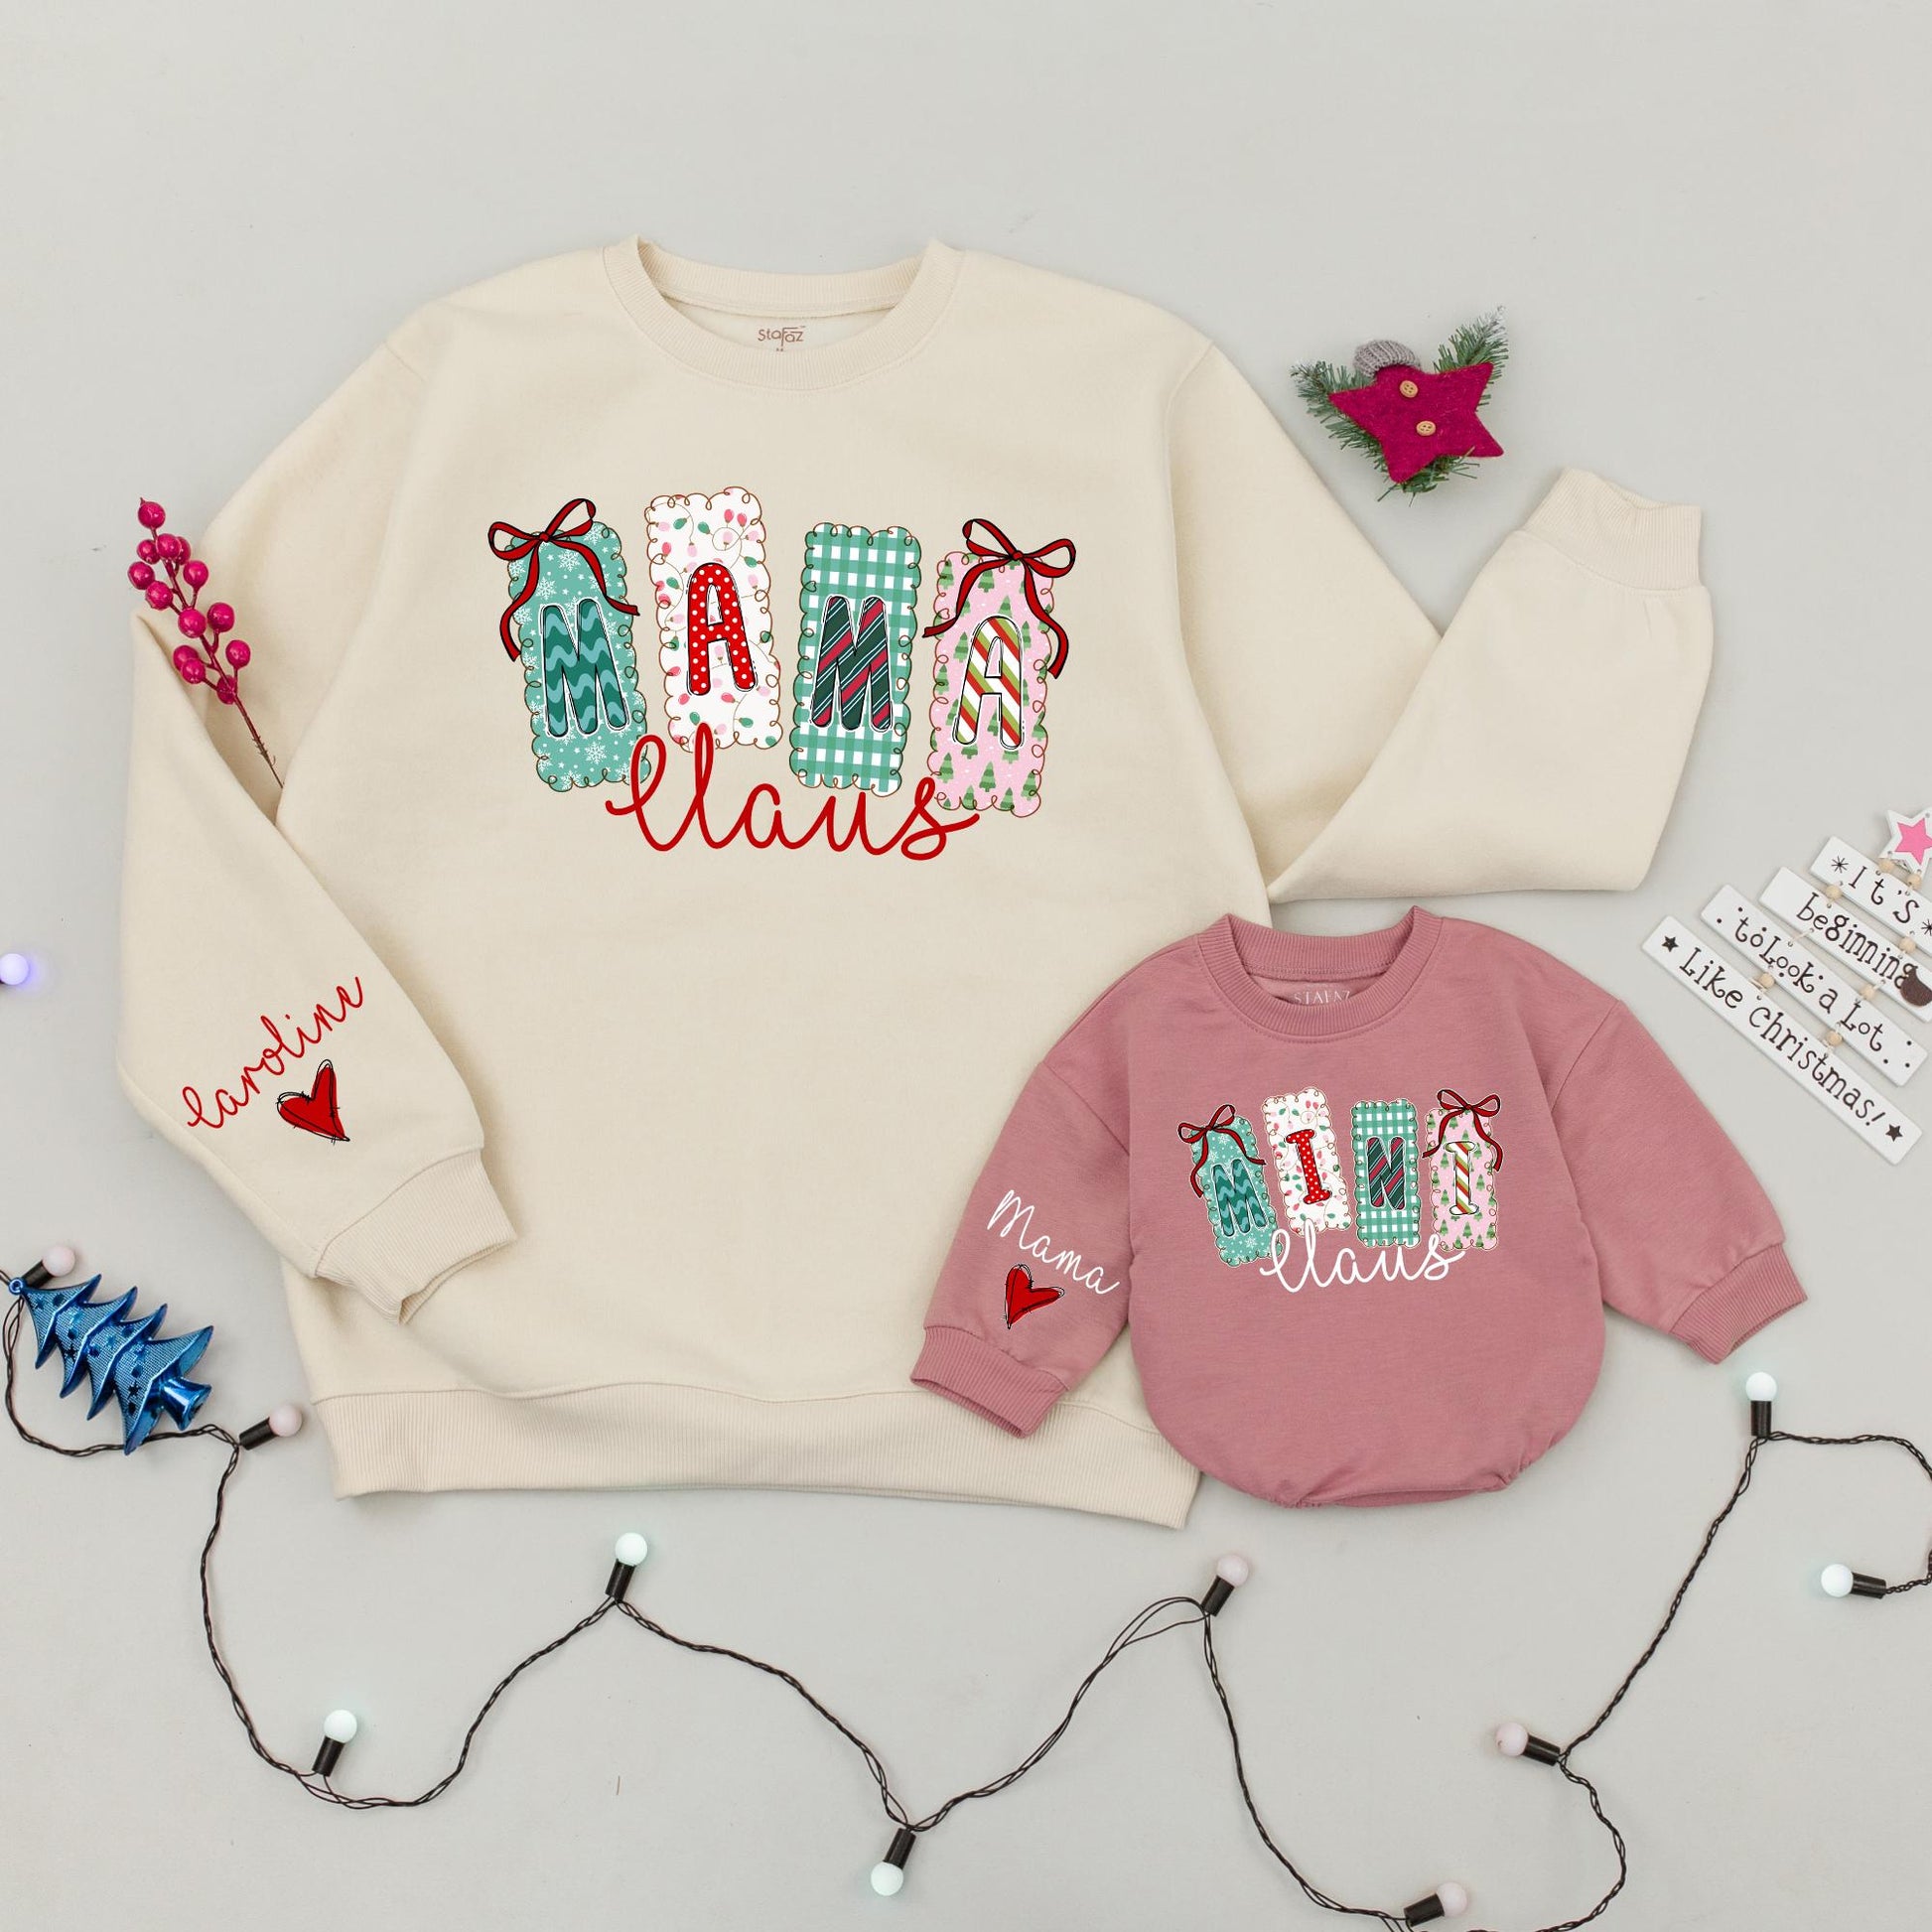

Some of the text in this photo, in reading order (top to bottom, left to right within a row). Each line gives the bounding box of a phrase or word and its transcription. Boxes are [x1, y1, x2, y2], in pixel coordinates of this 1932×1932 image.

[1679, 946, 1744, 1010] Like
[1818, 988, 1838, 1014] a
[987, 1189, 1121, 1295] Mama
